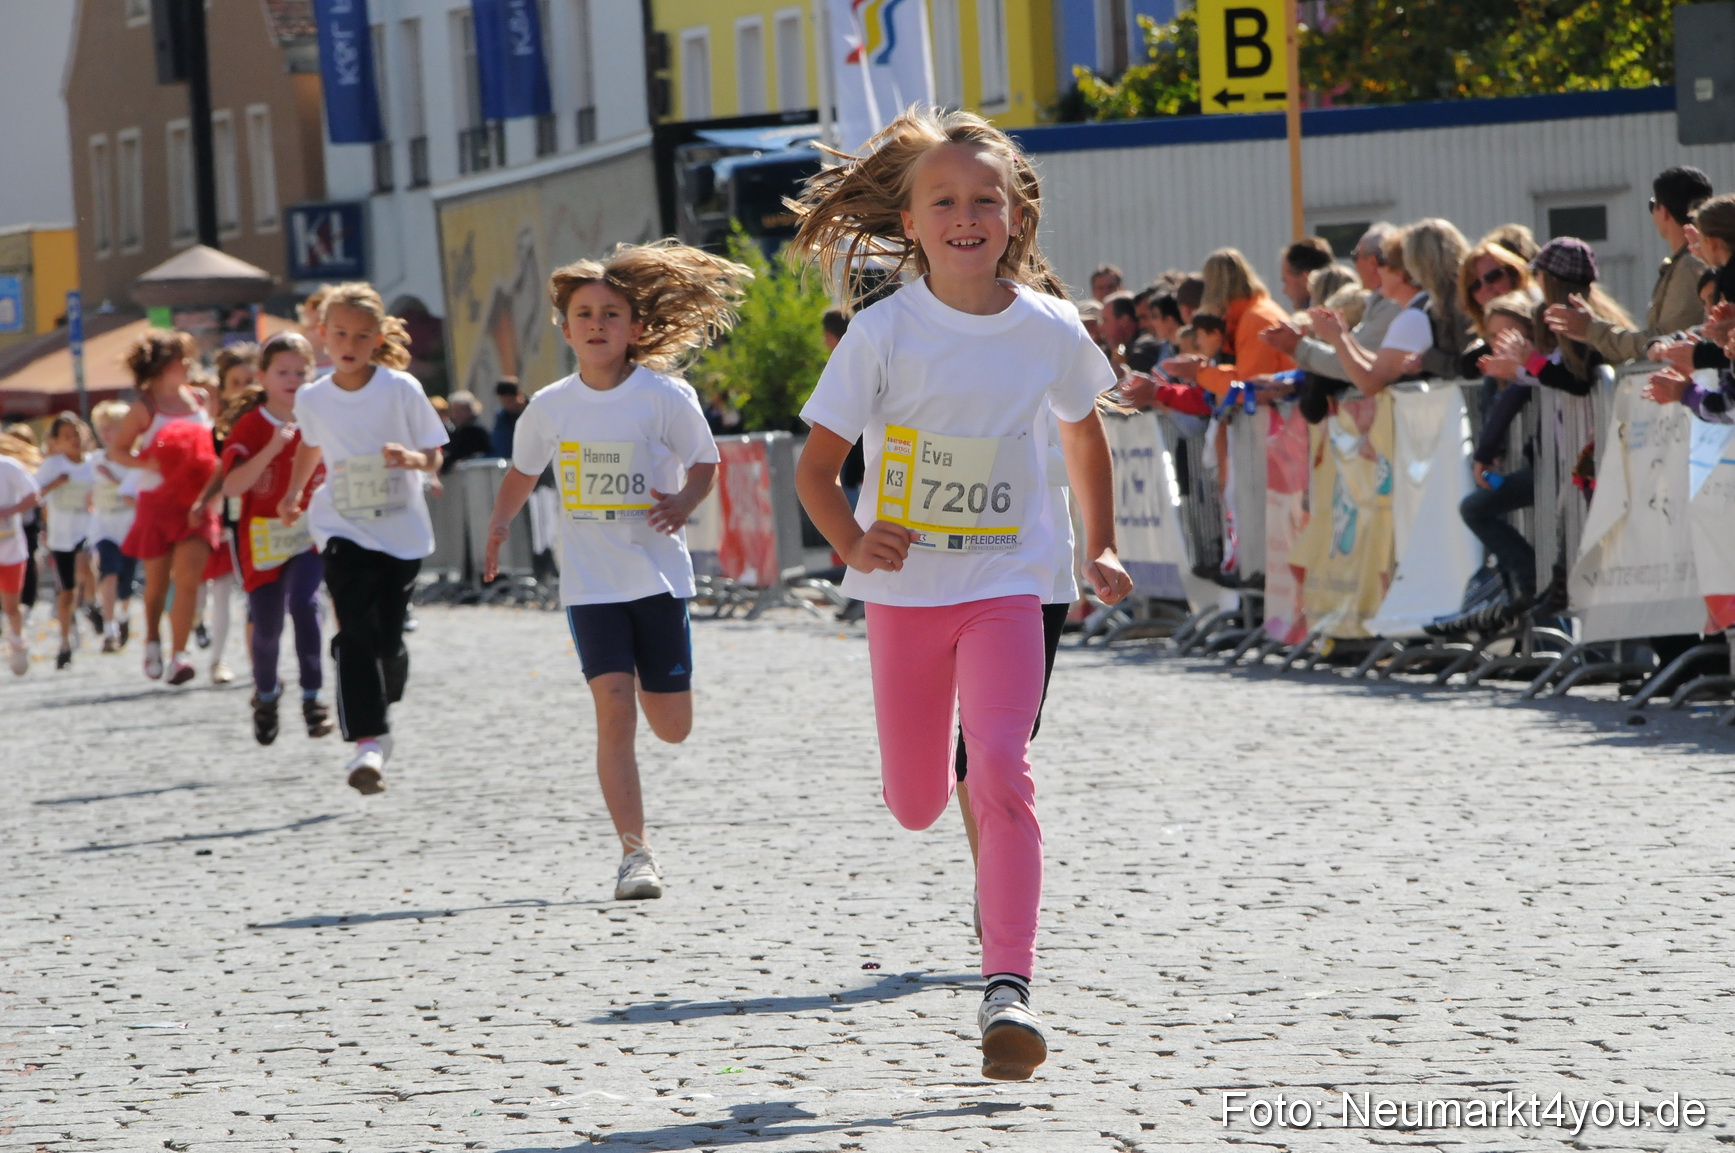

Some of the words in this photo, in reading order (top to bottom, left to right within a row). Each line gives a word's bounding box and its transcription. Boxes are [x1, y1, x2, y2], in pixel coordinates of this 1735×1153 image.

[1225, 8, 1272, 78] B
[584, 448, 620, 463] Hanna
[922, 441, 953, 467] Eva
[353, 477, 400, 500] 7147
[565, 472, 575, 483] K3
[585, 473, 646, 495] 7208
[886, 469, 904, 487] K3
[921, 478, 1012, 514] 7206
[964, 534, 1018, 545] PFLEIDERER
